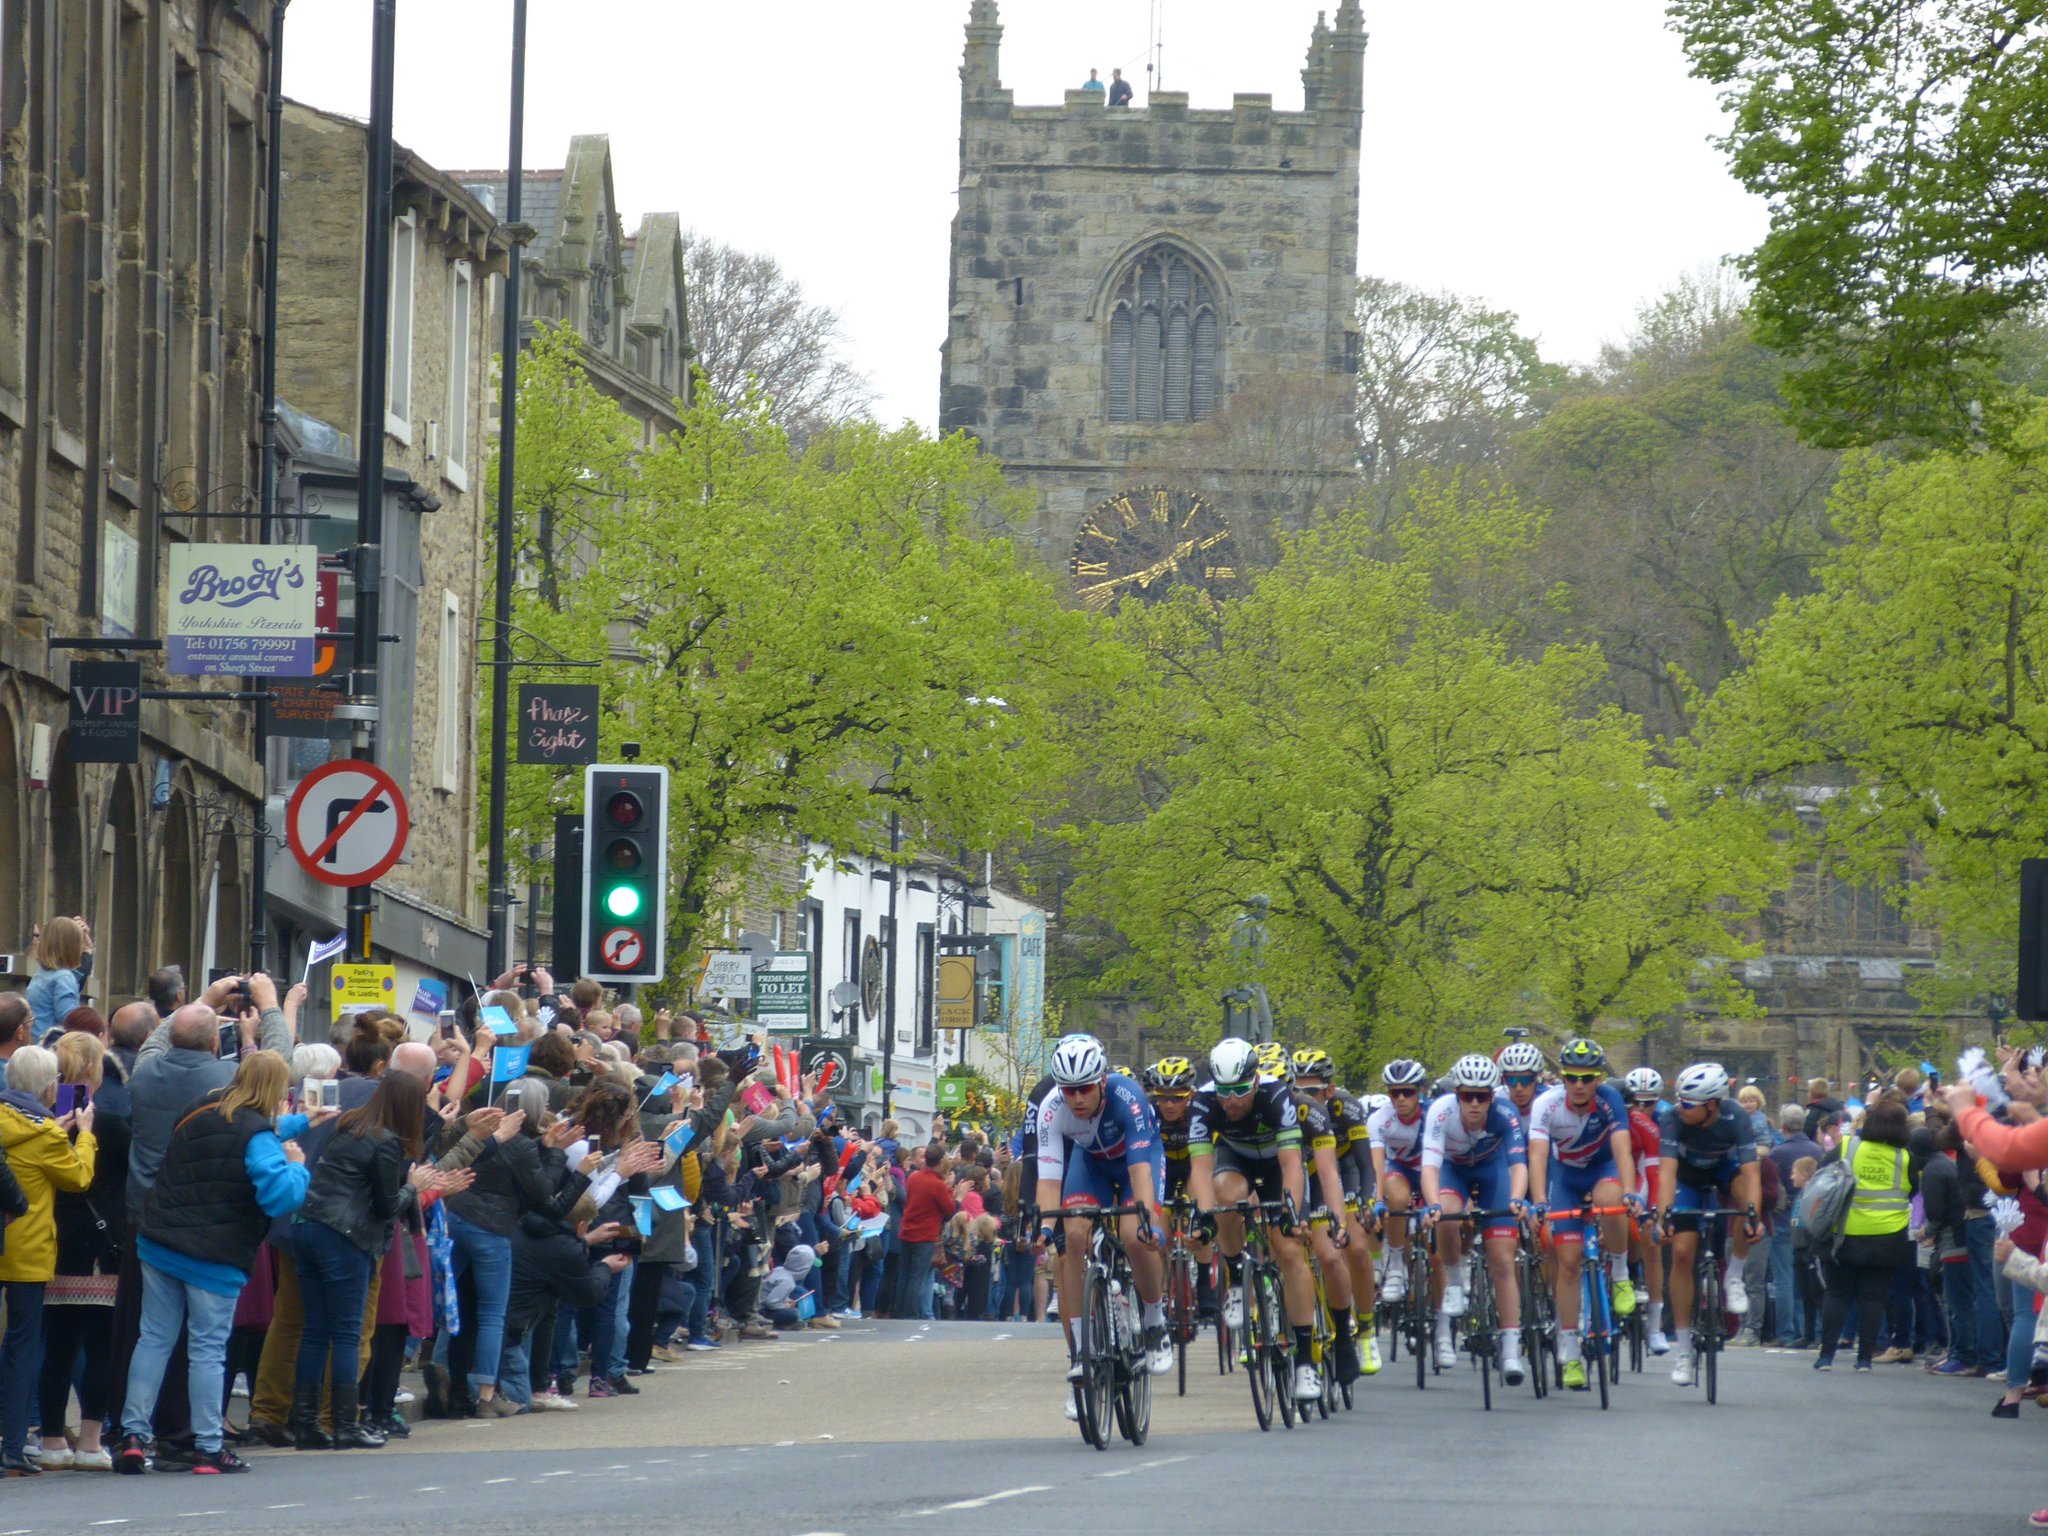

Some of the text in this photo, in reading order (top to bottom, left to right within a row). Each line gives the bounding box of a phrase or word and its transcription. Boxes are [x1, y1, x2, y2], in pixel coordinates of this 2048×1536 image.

[180, 558, 304, 608] Brody's
[177, 615, 242, 631] Yorkshire
[246, 615, 303, 630] Pizzeria
[184, 637, 296, 651] Tel: 01756 799991
[187, 652, 294, 662] entrance around corner
[204, 662, 276, 674] on Sheep Street
[71, 686, 138, 715] VIP
[529, 727, 586, 758] Eight
[1021, 938, 1041, 957] CAFE
[759, 983, 805, 993] TO LET
[1114, 1085, 1145, 1132] HSBC UK
[1025, 1101, 1039, 1135] SKY
[1859, 1174, 1889, 1182] MAKER
